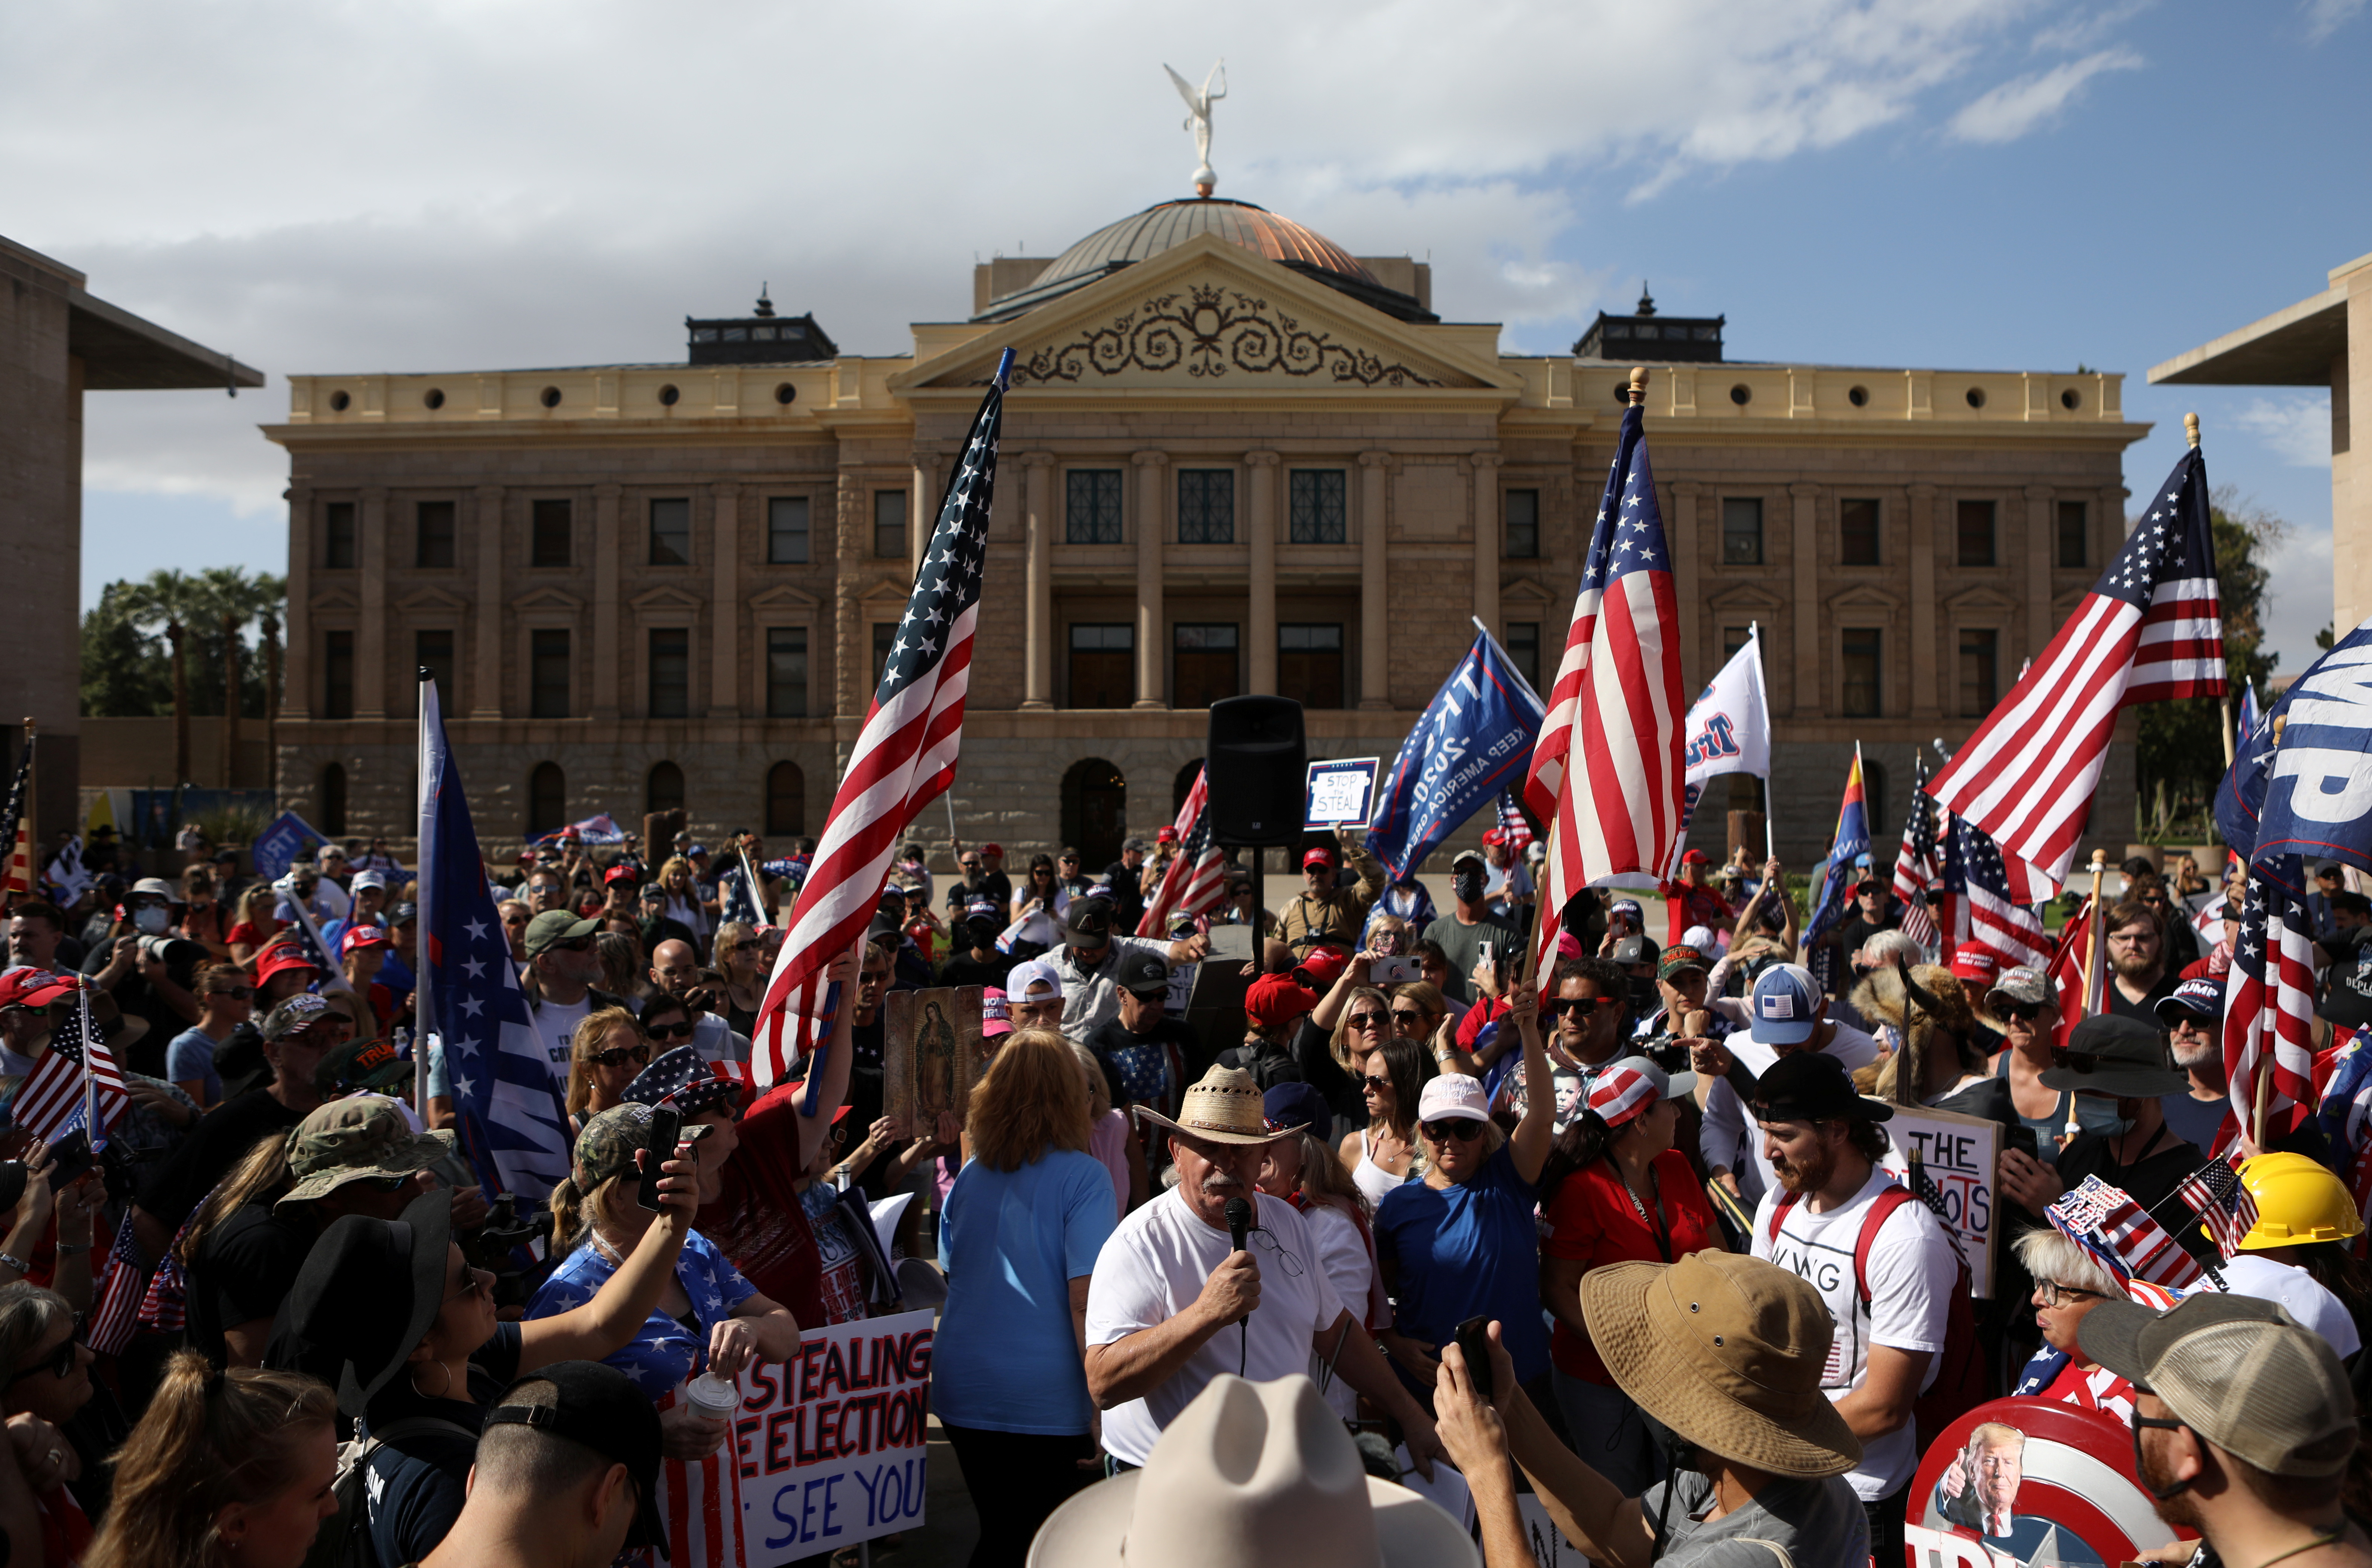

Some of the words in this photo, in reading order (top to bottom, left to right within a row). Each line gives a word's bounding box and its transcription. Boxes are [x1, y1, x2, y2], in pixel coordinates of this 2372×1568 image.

[1327, 774, 1357, 789] STOP
[1317, 796, 1359, 811] STEAL
[1086, 886, 1111, 897] TRUMP
[970, 904, 996, 912] TRUMP
[1612, 903, 1637, 914] TRUMP
[1662, 950, 1700, 965] TRUMP
[1970, 953, 1994, 964] AMERICA
[284, 994, 328, 1012] TRUMP
[1908, 1131, 1978, 1169] THE
[2077, 1173, 2126, 1210] TRUMP
[2049, 1190, 2106, 1236] 2020
[843, 1303, 864, 1324] 2020
[743, 1329, 932, 1413] STEALING
[767, 1381, 929, 1476] ELECTION
[765, 1473, 845, 1550] SEE
[854, 1458, 926, 1527] YOU
